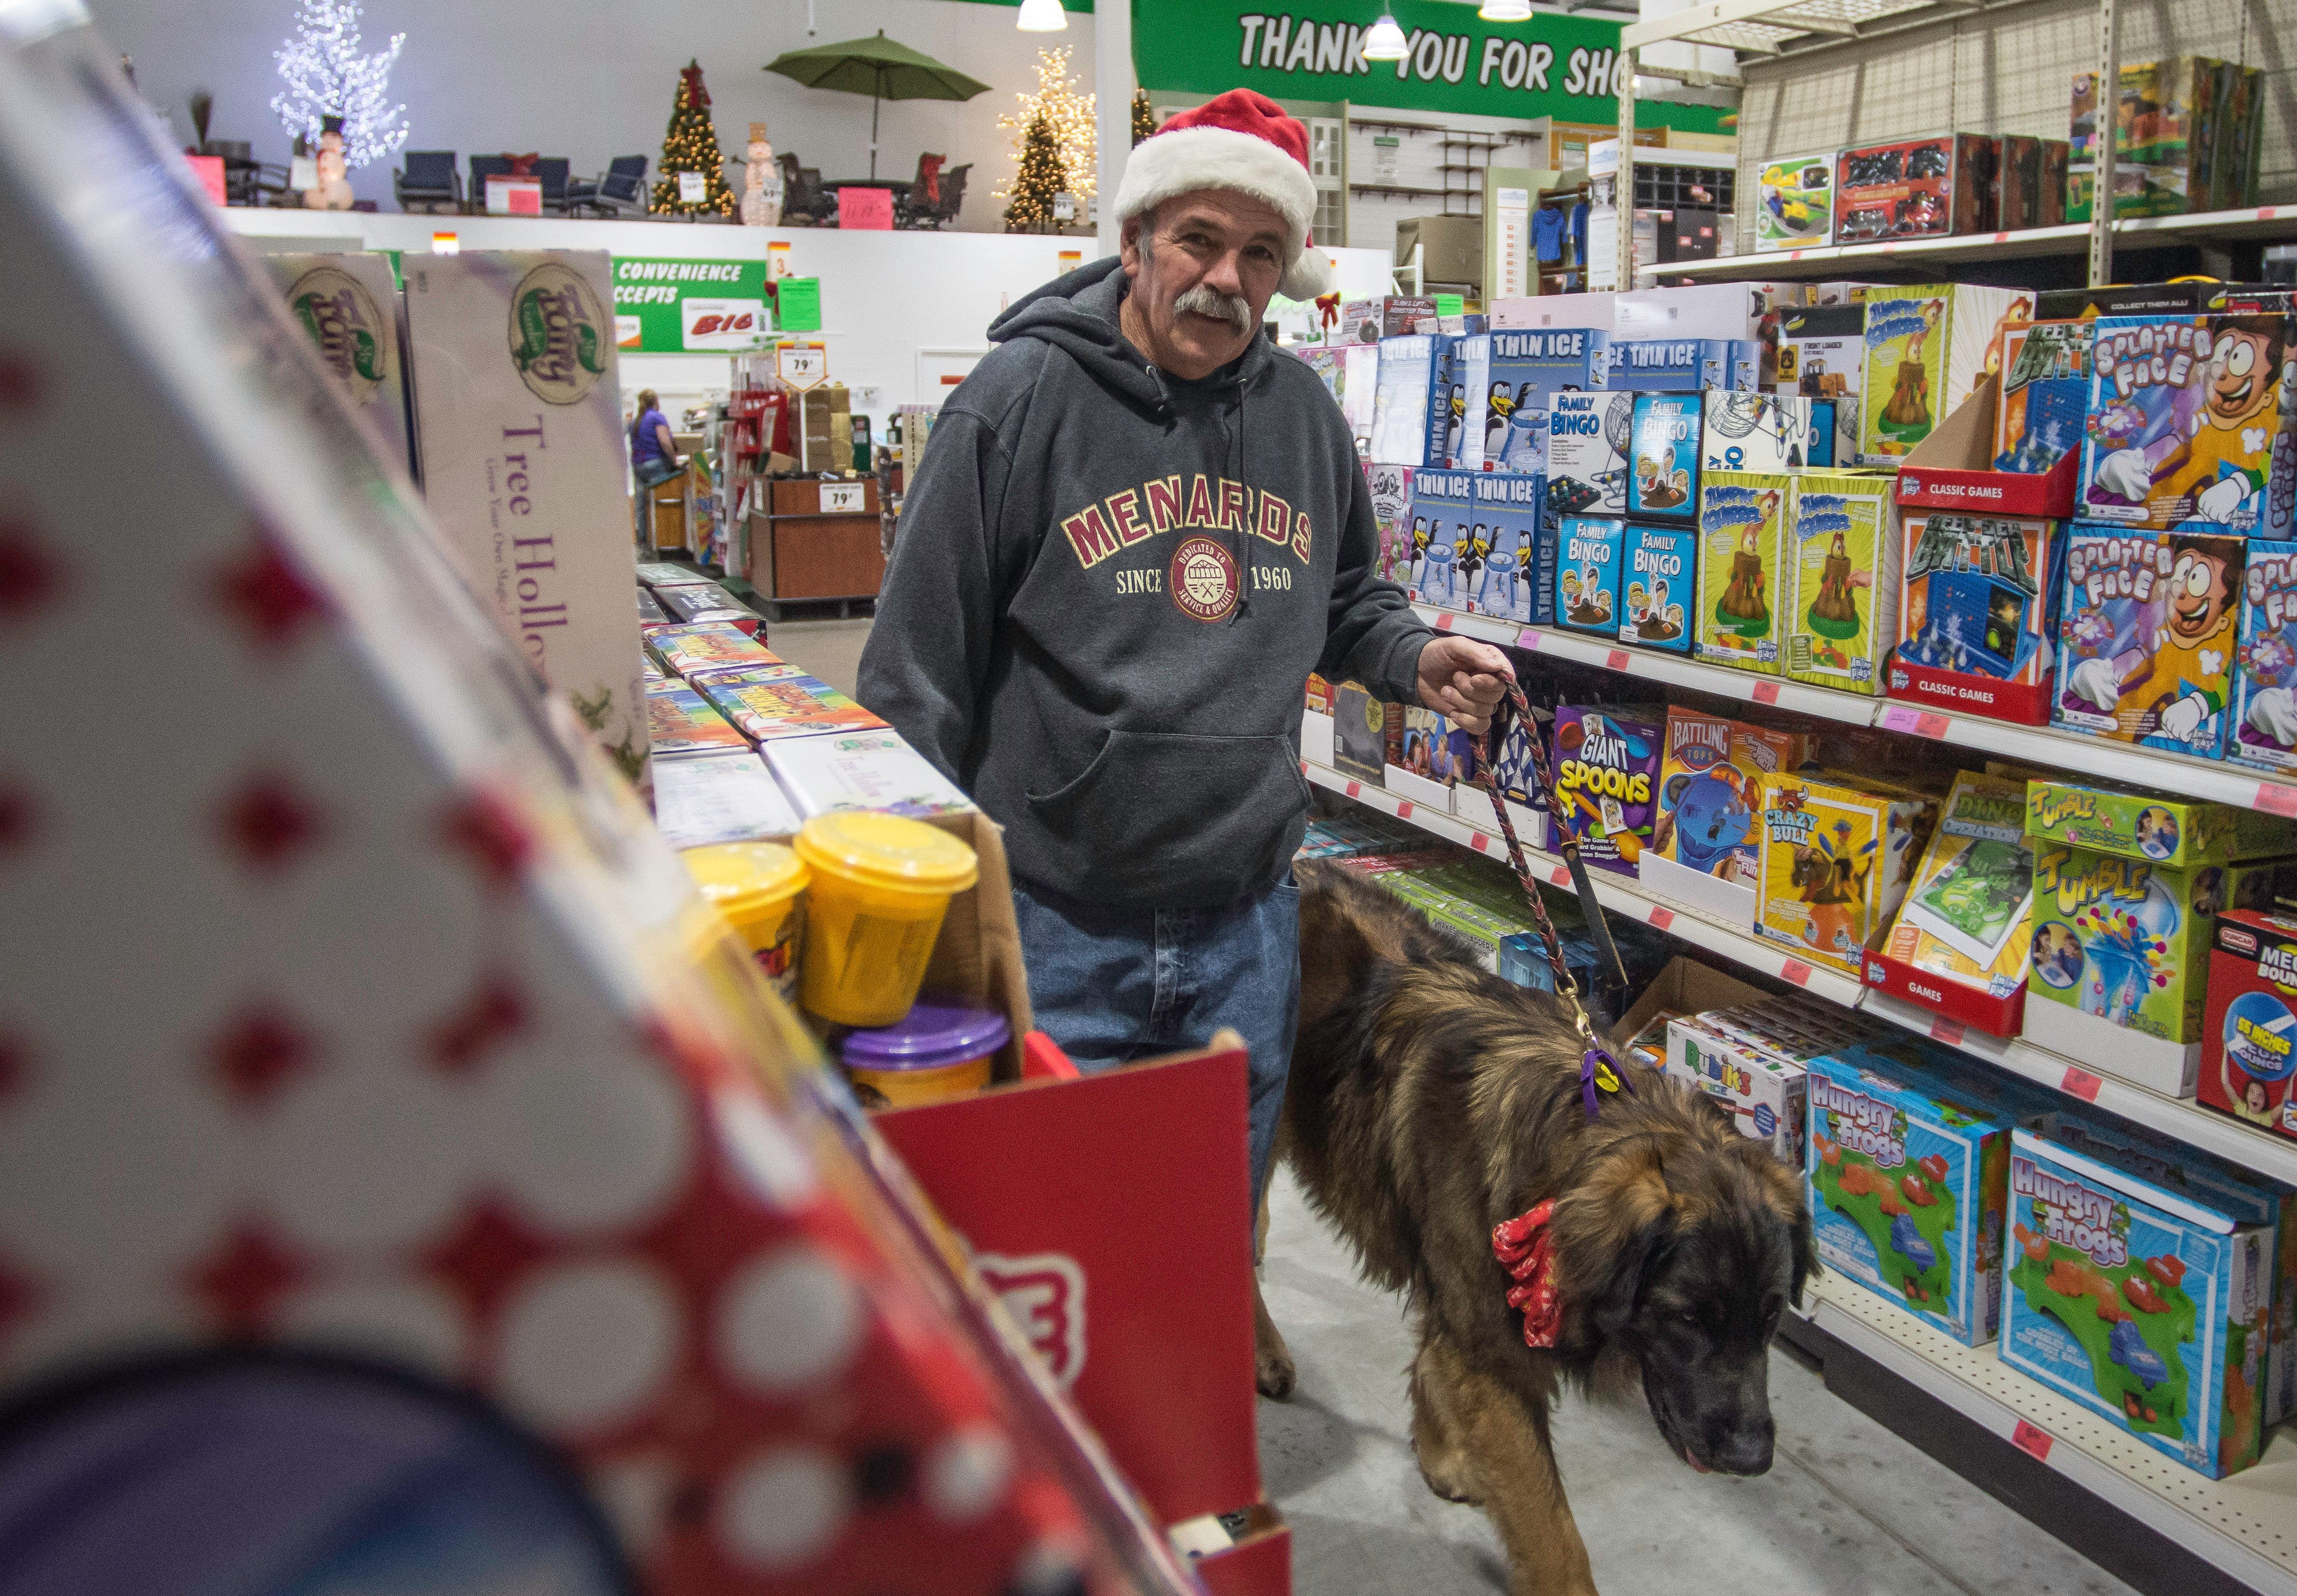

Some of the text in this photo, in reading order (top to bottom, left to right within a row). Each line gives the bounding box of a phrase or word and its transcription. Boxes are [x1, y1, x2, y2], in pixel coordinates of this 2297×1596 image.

[1239, 15, 1371, 75] THANK
[1397, 28, 1471, 84] YOU
[1479, 38, 1553, 91] FOR
[618, 262, 743, 281] CONVENIENCE
[613, 285, 678, 304] CCEPTS
[1494, 333, 1583, 358] THIN ICE
[1608, 346, 1625, 368] CE
[1629, 342, 1695, 368] THIN ICE
[2094, 321, 2215, 377] SPLATTER
[2114, 351, 2193, 399] FACE
[1558, 395, 1595, 411] FAMILY
[1650, 400, 1684, 416] FAMILY
[1430, 389, 1447, 462] THIN ICE
[1550, 412, 1599, 435] BINGO
[1643, 418, 1687, 441] BINGO
[1416, 473, 1470, 499] THIN ICE
[1475, 475, 1533, 504] THIN ICE
[1929, 484, 2003, 498] CLASSIC GAMES
[1061, 474, 1312, 570] MENARDS
[1576, 522, 1607, 540] FAMILY
[1702, 505, 1763, 537] SQUIRREL
[1796, 513, 1852, 543] SQUIRREL
[503, 414, 568, 660] Tree Hollo
[1568, 538, 1611, 563] BINGO
[1641, 531, 1677, 552] FAMILY
[1178, 544, 1227, 565] DEDICATED TO
[1634, 551, 1681, 576] BINGO
[2068, 536, 2174, 585] SPLATTER
[1117, 566, 1291, 593] SINCE 1960
[1538, 537, 1554, 616] THIN ICE
[2087, 567, 2156, 608] FACE
[1178, 588, 1234, 615] SERVICE & QUALITY
[1919, 680, 1994, 704] CLASSIC GAMES
[1580, 733, 1629, 771] GIANT
[1674, 721, 1728, 756] BATTLING
[1687, 749, 1714, 762] TOPS
[1560, 759, 1652, 804] SPOONS
[1764, 809, 1819, 833] CRAZY
[2029, 787, 2097, 829] TUMBLE
[1773, 827, 1810, 847] BULL
[2037, 846, 2151, 917] TUMBLE
[1908, 981, 1943, 1003] GAMES
[1685, 1039, 1751, 1096] Rubik's
[1810, 1073, 1896, 1136] Hungry
[1838, 1115, 1905, 1168] Frogs
[2012, 1156, 2114, 1230] Hungry
[2045, 1205, 2127, 1266] Frogs
